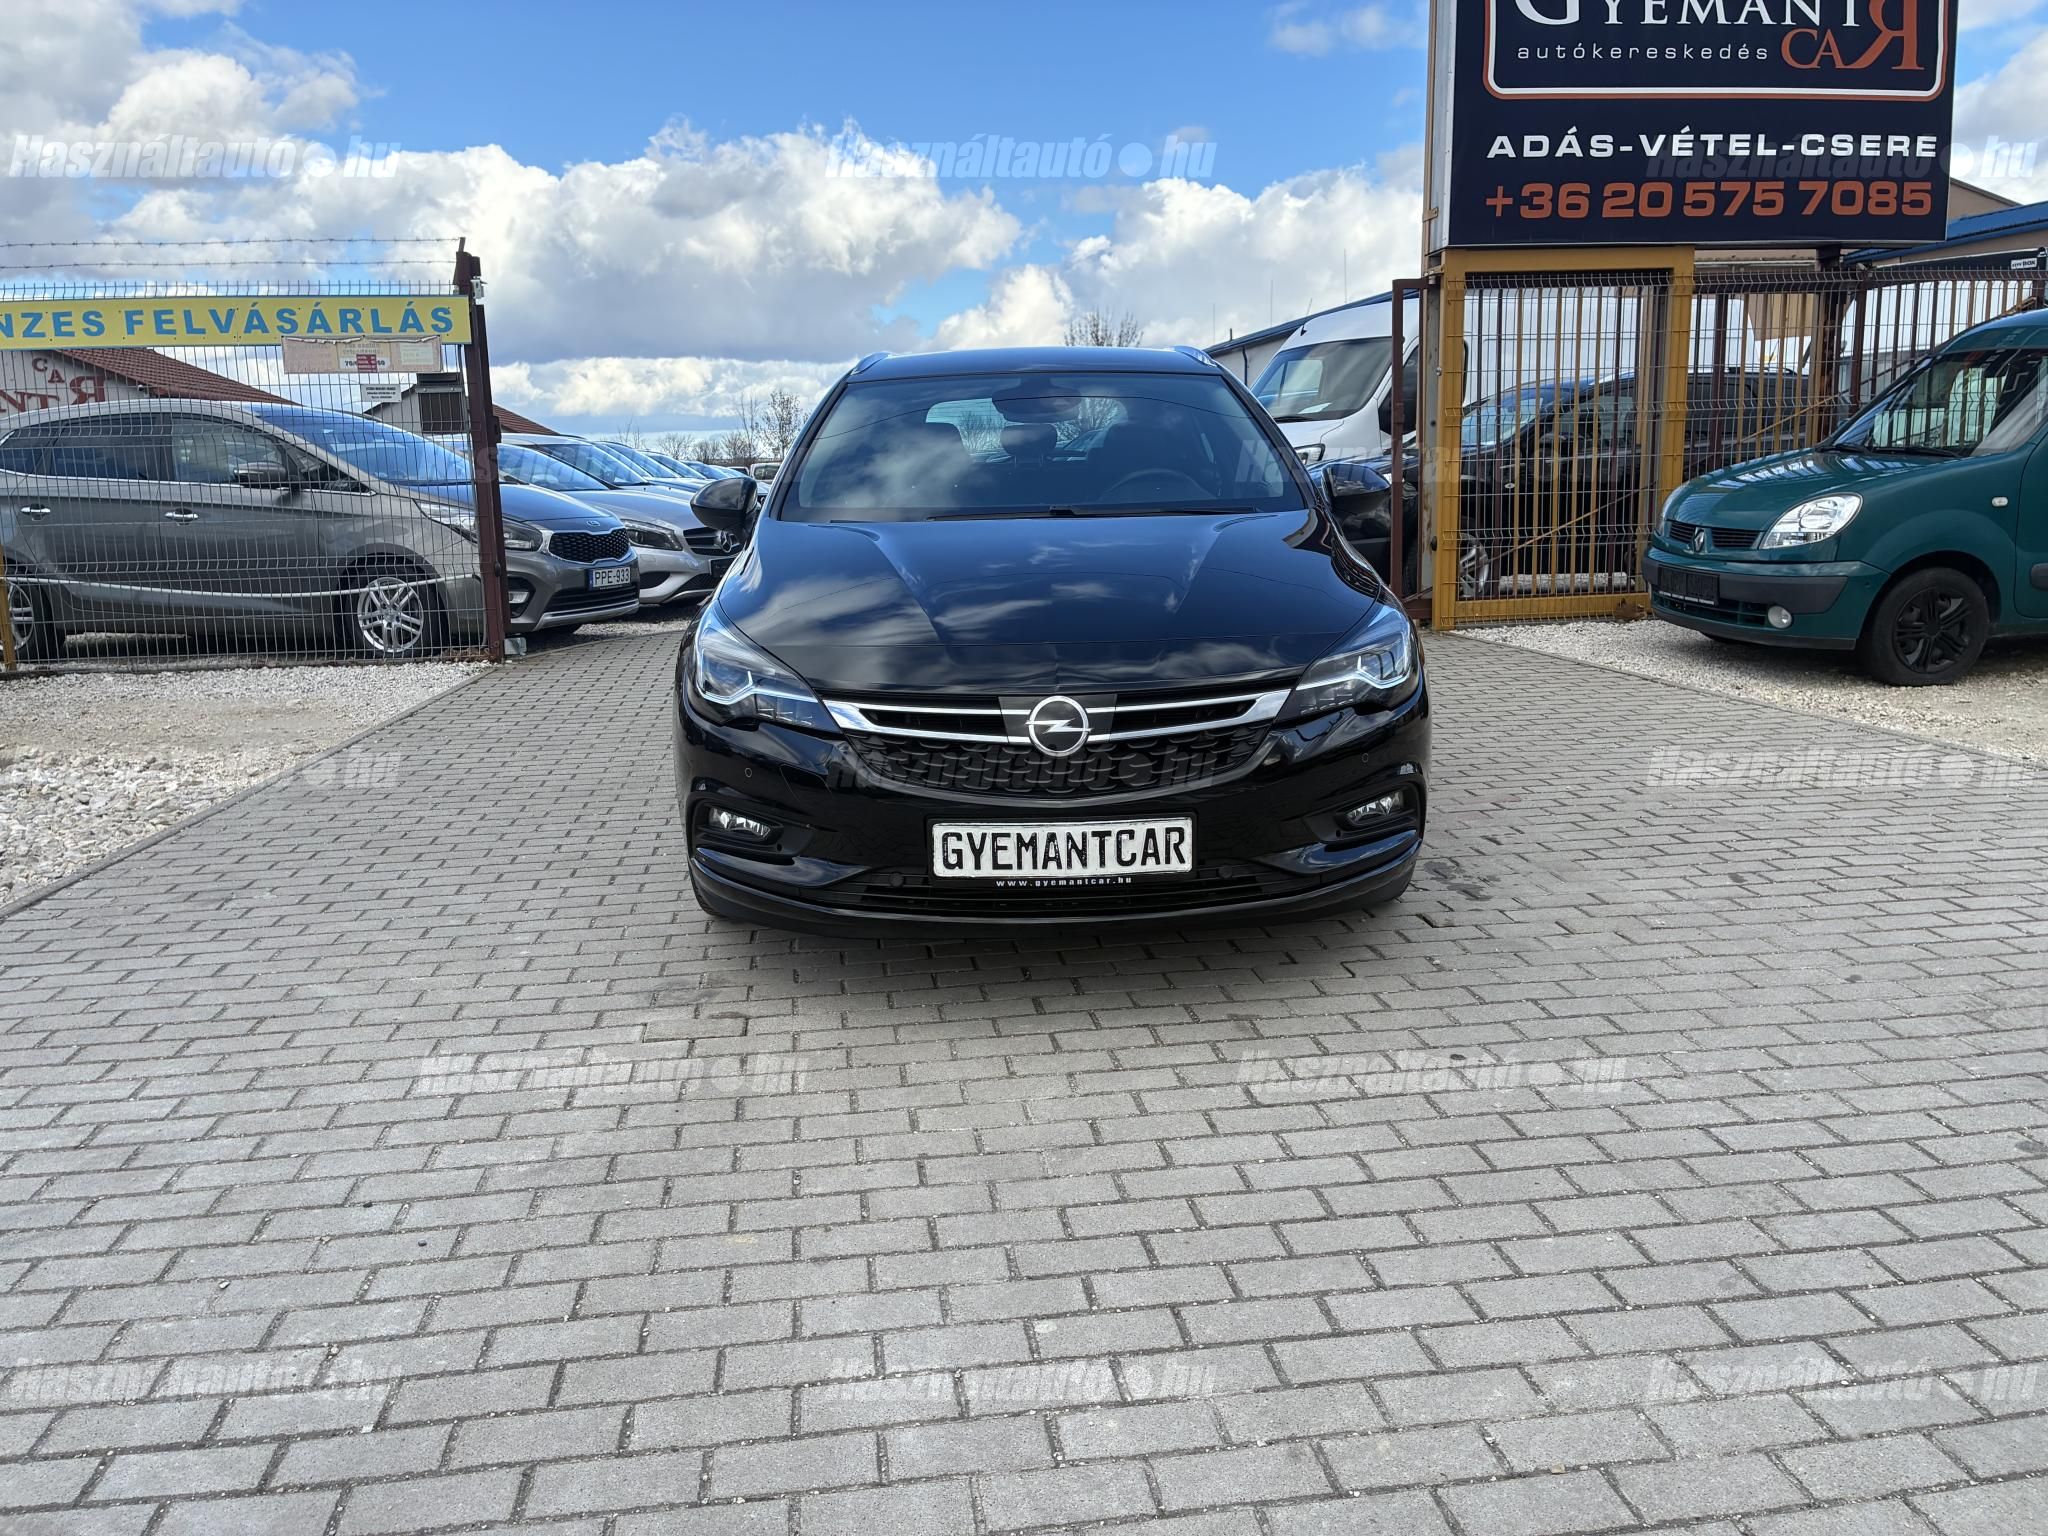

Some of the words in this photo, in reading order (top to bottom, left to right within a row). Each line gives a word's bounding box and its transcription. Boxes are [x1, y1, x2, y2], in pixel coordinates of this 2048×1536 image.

[1518, 43, 1768, 60] autókereskedés
[1487, 125, 1937, 158] ADÁS-VÉTEL-CSERE
[1486, 182, 1591, 219] +36
[1602, 181, 1673, 218] 20
[1683, 181, 1785, 217] 575
[1798, 180, 1932, 216] 7085
[124, 301, 453, 335] FELVÁSÁRLÁS
[594, 568, 630, 585] PPE-933
[941, 826, 1186, 870] GYEMANTCAR
[996, 876, 1132, 887] www.gyemantcar.hu
